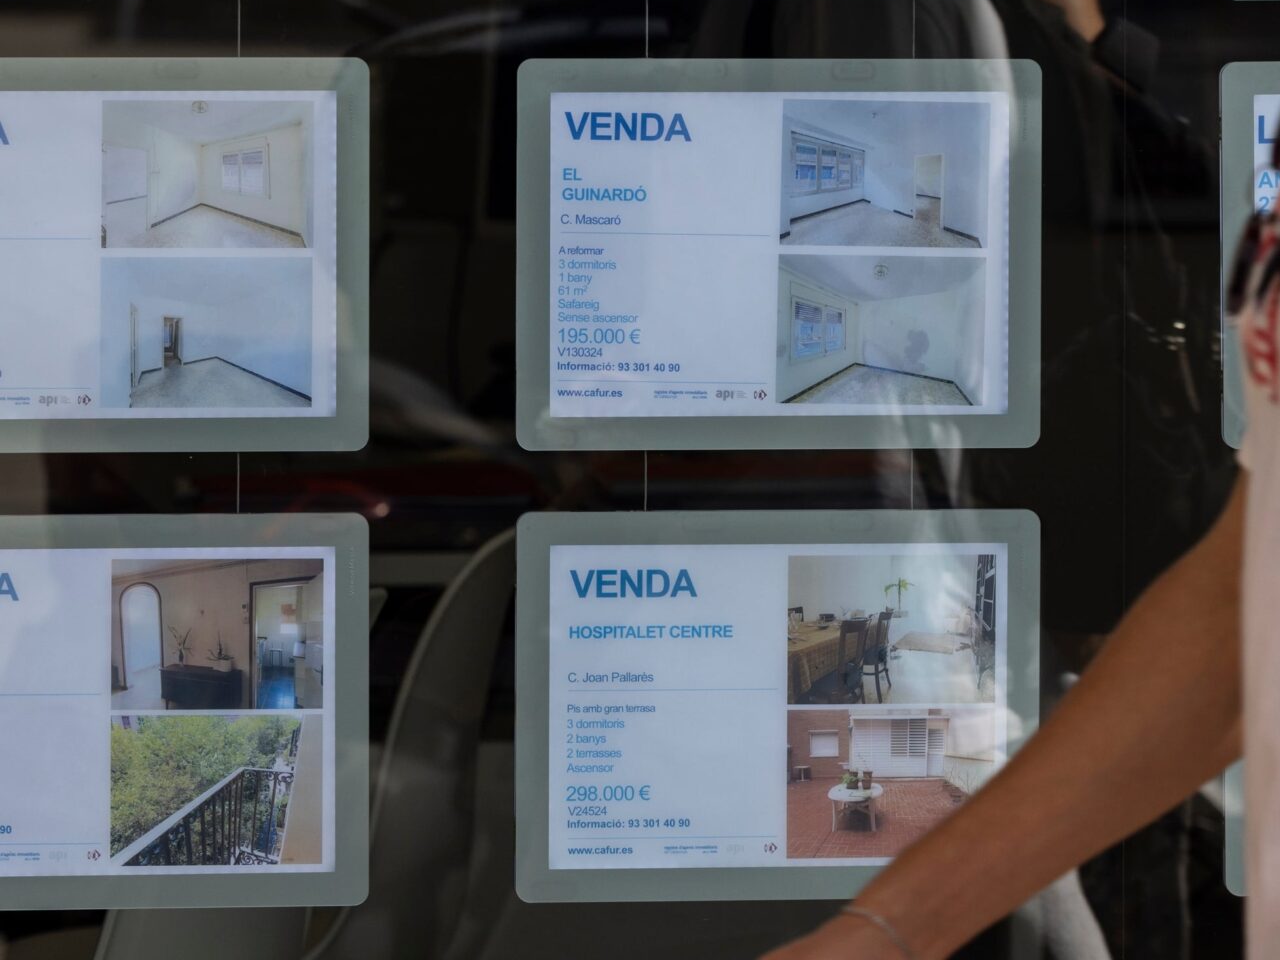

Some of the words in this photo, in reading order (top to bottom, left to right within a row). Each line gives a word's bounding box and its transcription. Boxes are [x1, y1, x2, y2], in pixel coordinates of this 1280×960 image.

[565, 112, 691, 142] VENDA
[562, 168, 582, 181] EL
[562, 186, 646, 201] GUINARDÓ
[560, 214, 572, 224] C.
[576, 214, 621, 225] Mascaró
[558, 312, 589, 322] Sense
[592, 313, 638, 323] ascensor
[558, 328, 625, 344] 195.000
[630, 329, 641, 344] €
[557, 347, 602, 357] V130324
[557, 362, 614, 371] Informació:
[618, 362, 629, 371] 93
[633, 363, 649, 372] 301
[654, 363, 665, 372] 40
[669, 364, 680, 372] 90
[557, 389, 622, 398] www.cafur.es
[570, 569, 697, 598] VENDA
[569, 625, 665, 639] HOSPITALET
[669, 625, 733, 638] CENTRE
[568, 673, 579, 682] C.
[583, 673, 608, 682] Joan
[567, 704, 580, 713] Pis
[583, 704, 602, 713] amb
[604, 705, 623, 715] gran
[626, 704, 655, 713] terrasa
[576, 719, 624, 728] dormitoris
[576, 734, 606, 746] banys
[576, 749, 622, 759] terrasses
[567, 763, 613, 773] Ascensor
[566, 786, 634, 802] 298.000
[639, 785, 651, 801] €
[568, 806, 607, 816] V24524
[567, 820, 625, 829] Informació:
[628, 819, 640, 828] 93
[643, 819, 660, 828] 301
[664, 819, 675, 828] 40
[678, 819, 690, 827] 90
[568, 846, 633, 855] www.cafur.es
